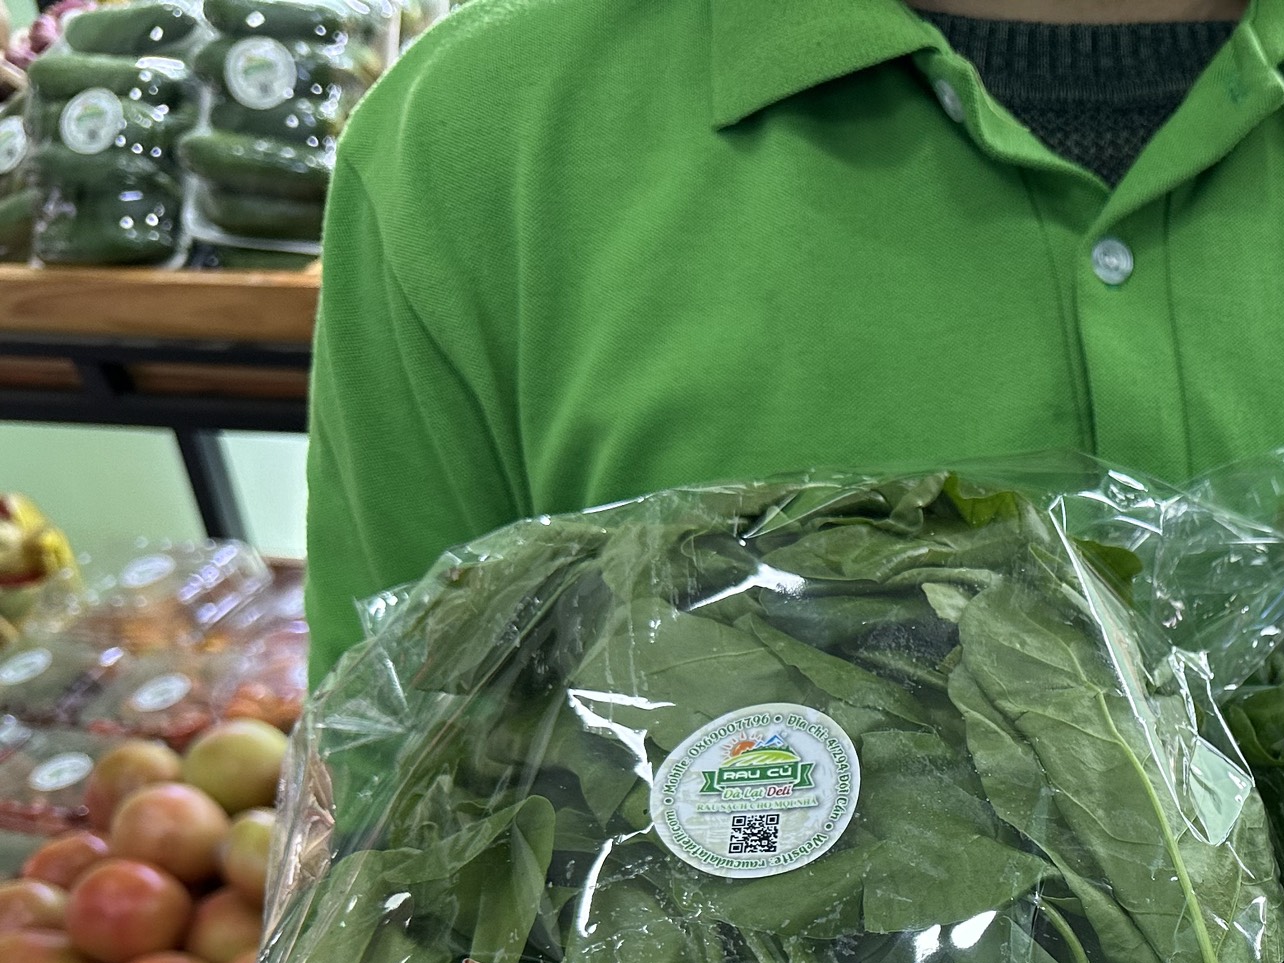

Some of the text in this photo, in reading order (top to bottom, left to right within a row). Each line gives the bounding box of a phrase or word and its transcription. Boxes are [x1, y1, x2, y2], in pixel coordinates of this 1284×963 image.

[663, 714, 770, 794] Mobile: 0869007796
[723, 764, 793, 780] RAU CỦ
[787, 714, 808, 730] Địa
[827, 738, 849, 772] 4/294
[723, 785, 791, 800] Đà Lạt Deli
[666, 810, 828, 869] Website: raucudalatdeli.com
